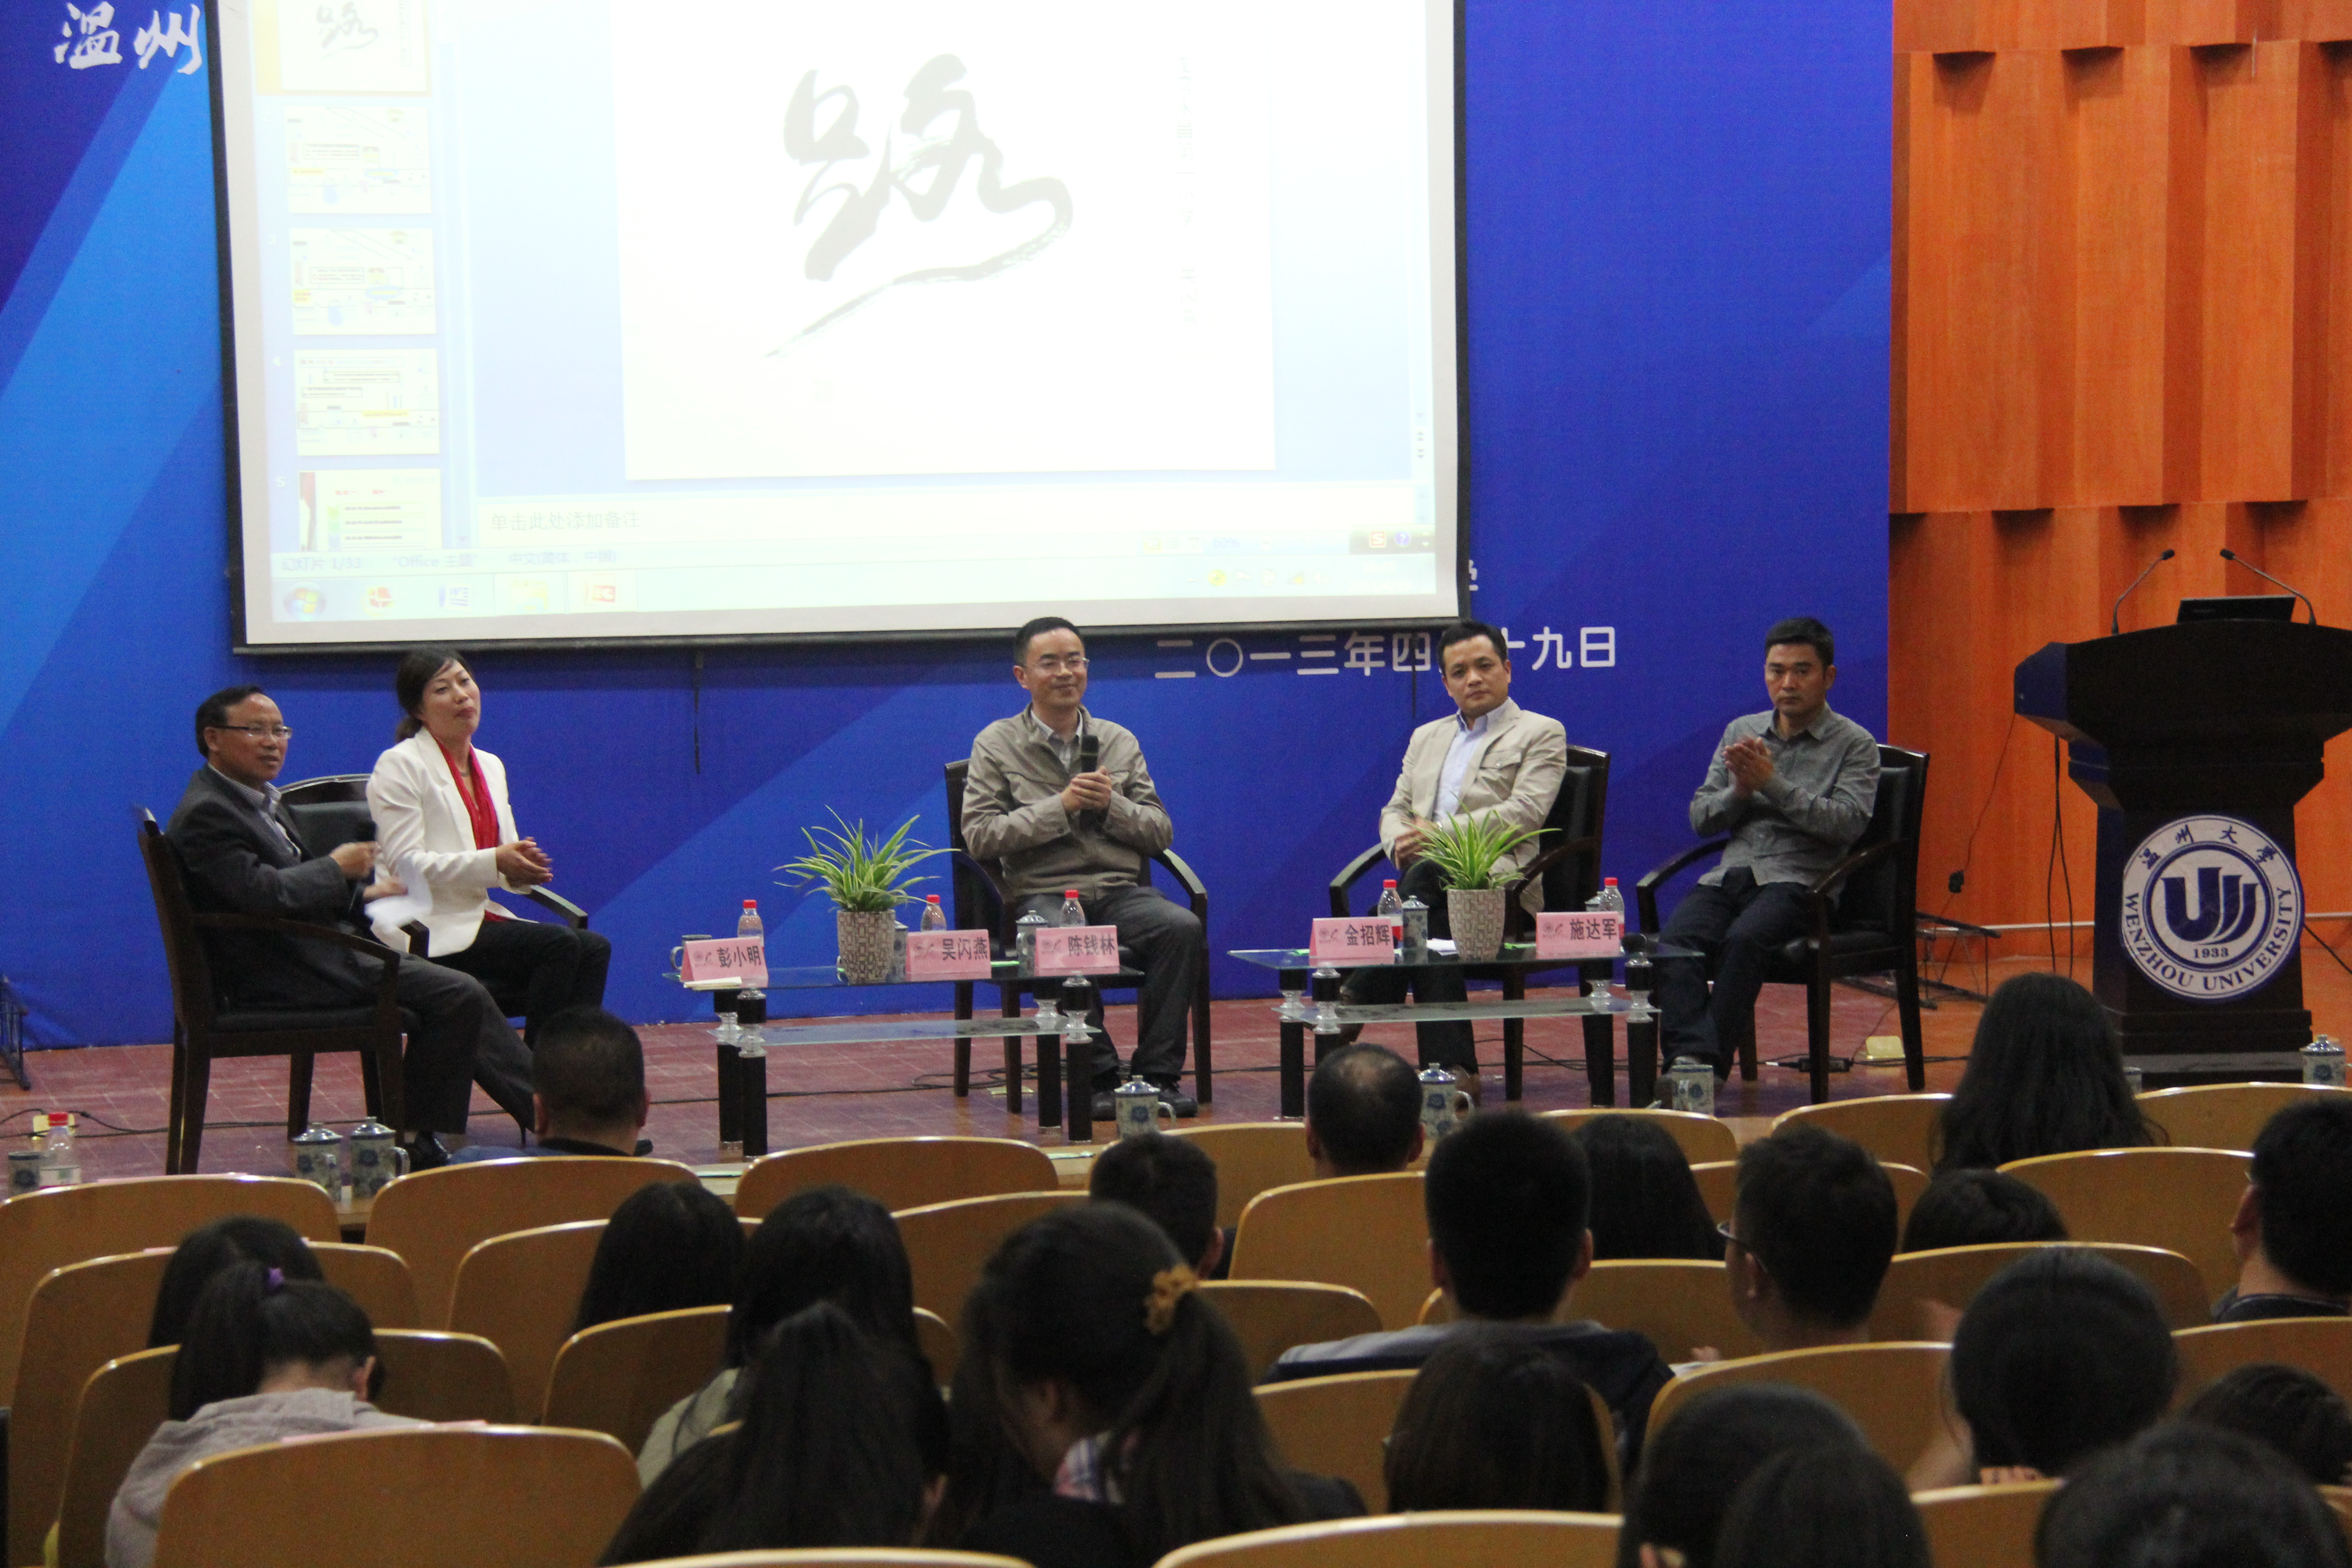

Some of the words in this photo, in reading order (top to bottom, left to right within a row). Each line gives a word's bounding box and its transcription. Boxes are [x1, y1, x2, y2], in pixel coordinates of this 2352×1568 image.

[276, 477, 286, 488] 5
[490, 510, 641, 532] 单击此处添加备注
[1213, 537, 1240, 549] 60%
[282, 557, 325, 571] 幻灯片
[331, 557, 361, 571] 1/33
[1345, 924, 1390, 946] 金招辉
[1570, 918, 1617, 940] 施达军
[2125, 892, 2194, 987] WENZHOU
[2203, 887, 2293, 990] UNIVERSITY
[717, 946, 761, 968] 彭小明
[942, 937, 988, 960] 吴闪燕
[2193, 947, 2229, 959] 1933
